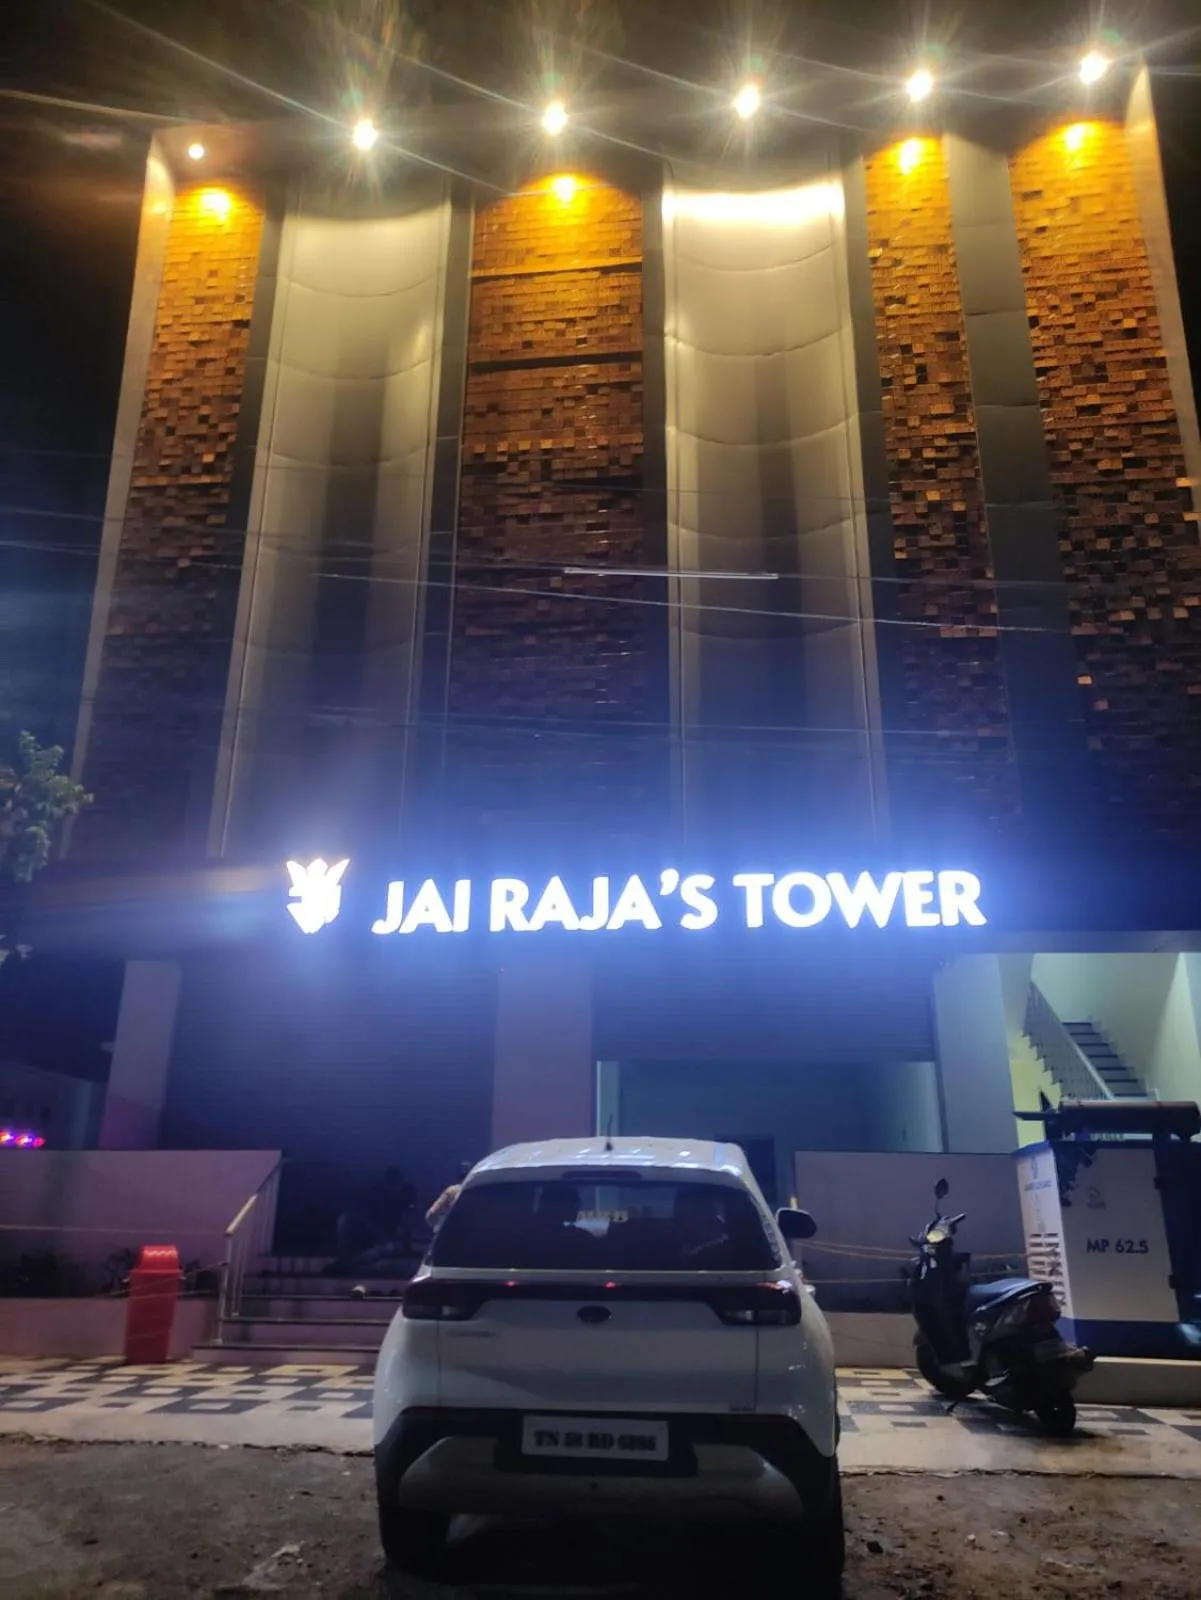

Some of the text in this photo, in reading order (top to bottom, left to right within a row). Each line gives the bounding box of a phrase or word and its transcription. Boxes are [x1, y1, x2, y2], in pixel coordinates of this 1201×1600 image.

[372, 868, 987, 935] JAI RAJA'S TOWER
[1086, 1238, 1110, 1253] MP
[533, 1429, 560, 1447] TN
